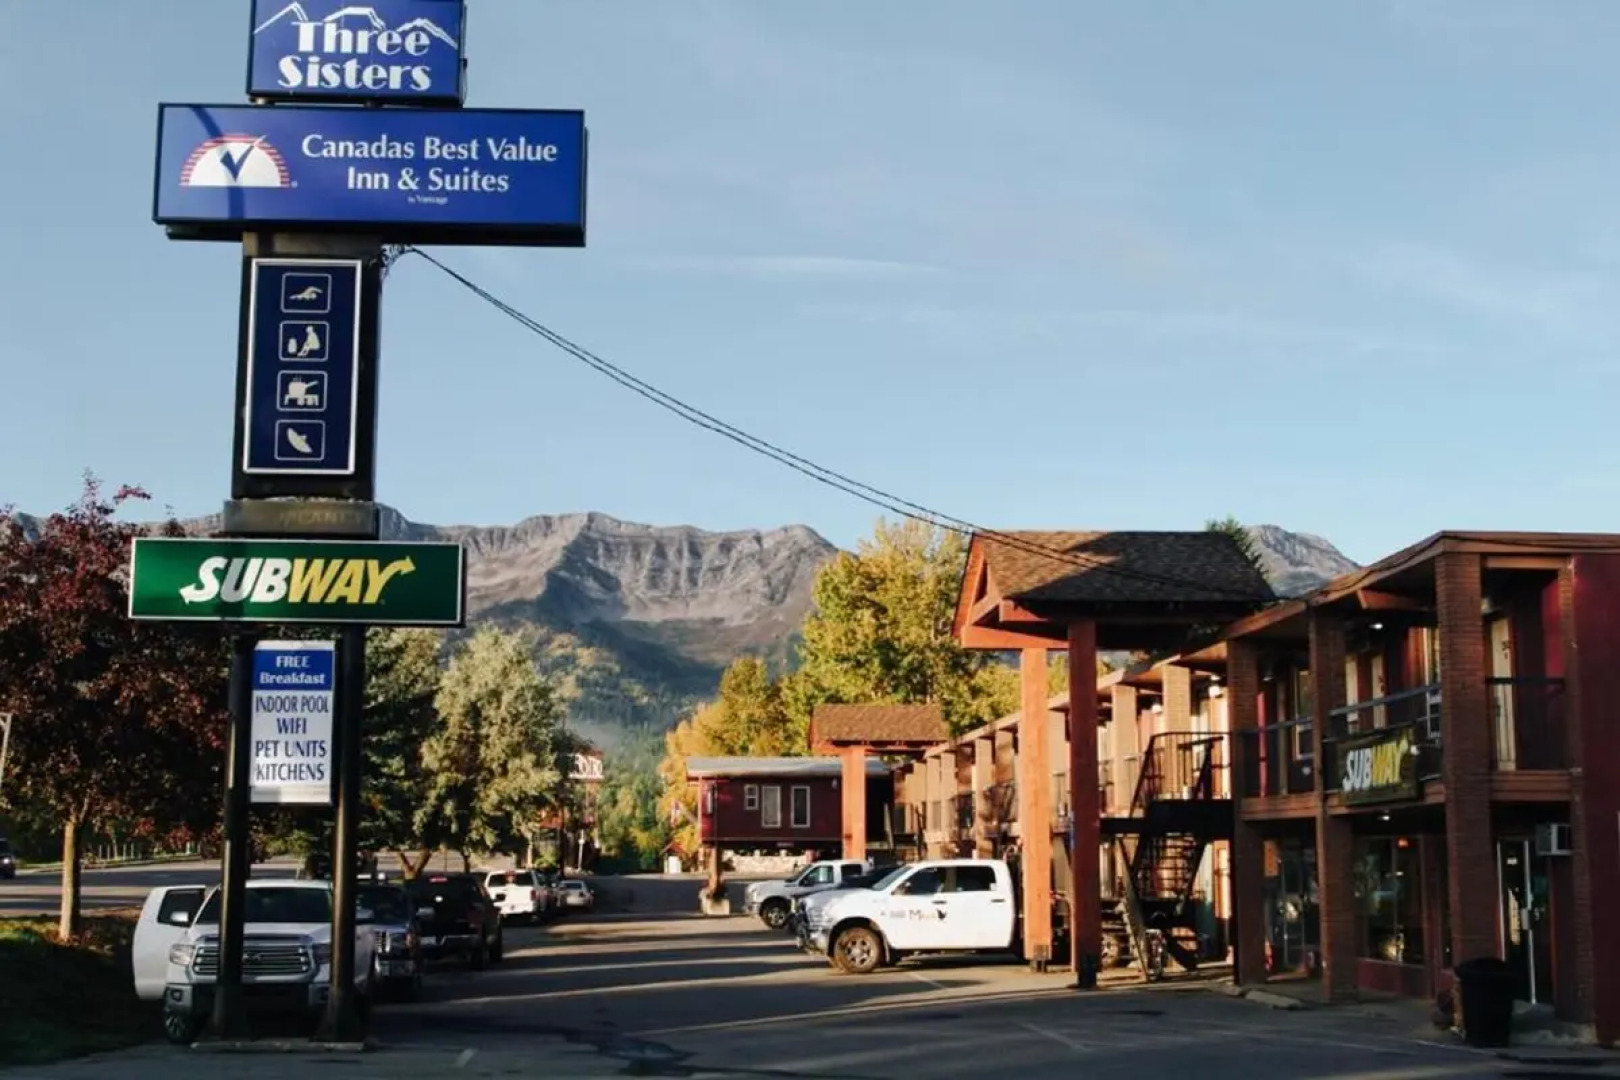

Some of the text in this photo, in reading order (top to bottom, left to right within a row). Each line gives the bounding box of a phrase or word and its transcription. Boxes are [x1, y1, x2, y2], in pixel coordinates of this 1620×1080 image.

[291, 20, 431, 56] Three
[277, 54, 432, 91] Sisters
[302, 134, 558, 162] Canadas Best Value
[348, 166, 509, 192] Inn & Suites
[179, 556, 416, 604] SUBWAY
[275, 655, 310, 668] FREE
[259, 671, 325, 684] Breakfast
[255, 696, 329, 713] INDOOR POOL
[276, 718, 307, 734] WIFI
[255, 740, 327, 757] PET UNITS
[256, 763, 325, 781] KITCHENS
[1342, 735, 1409, 792] SUBWAY
